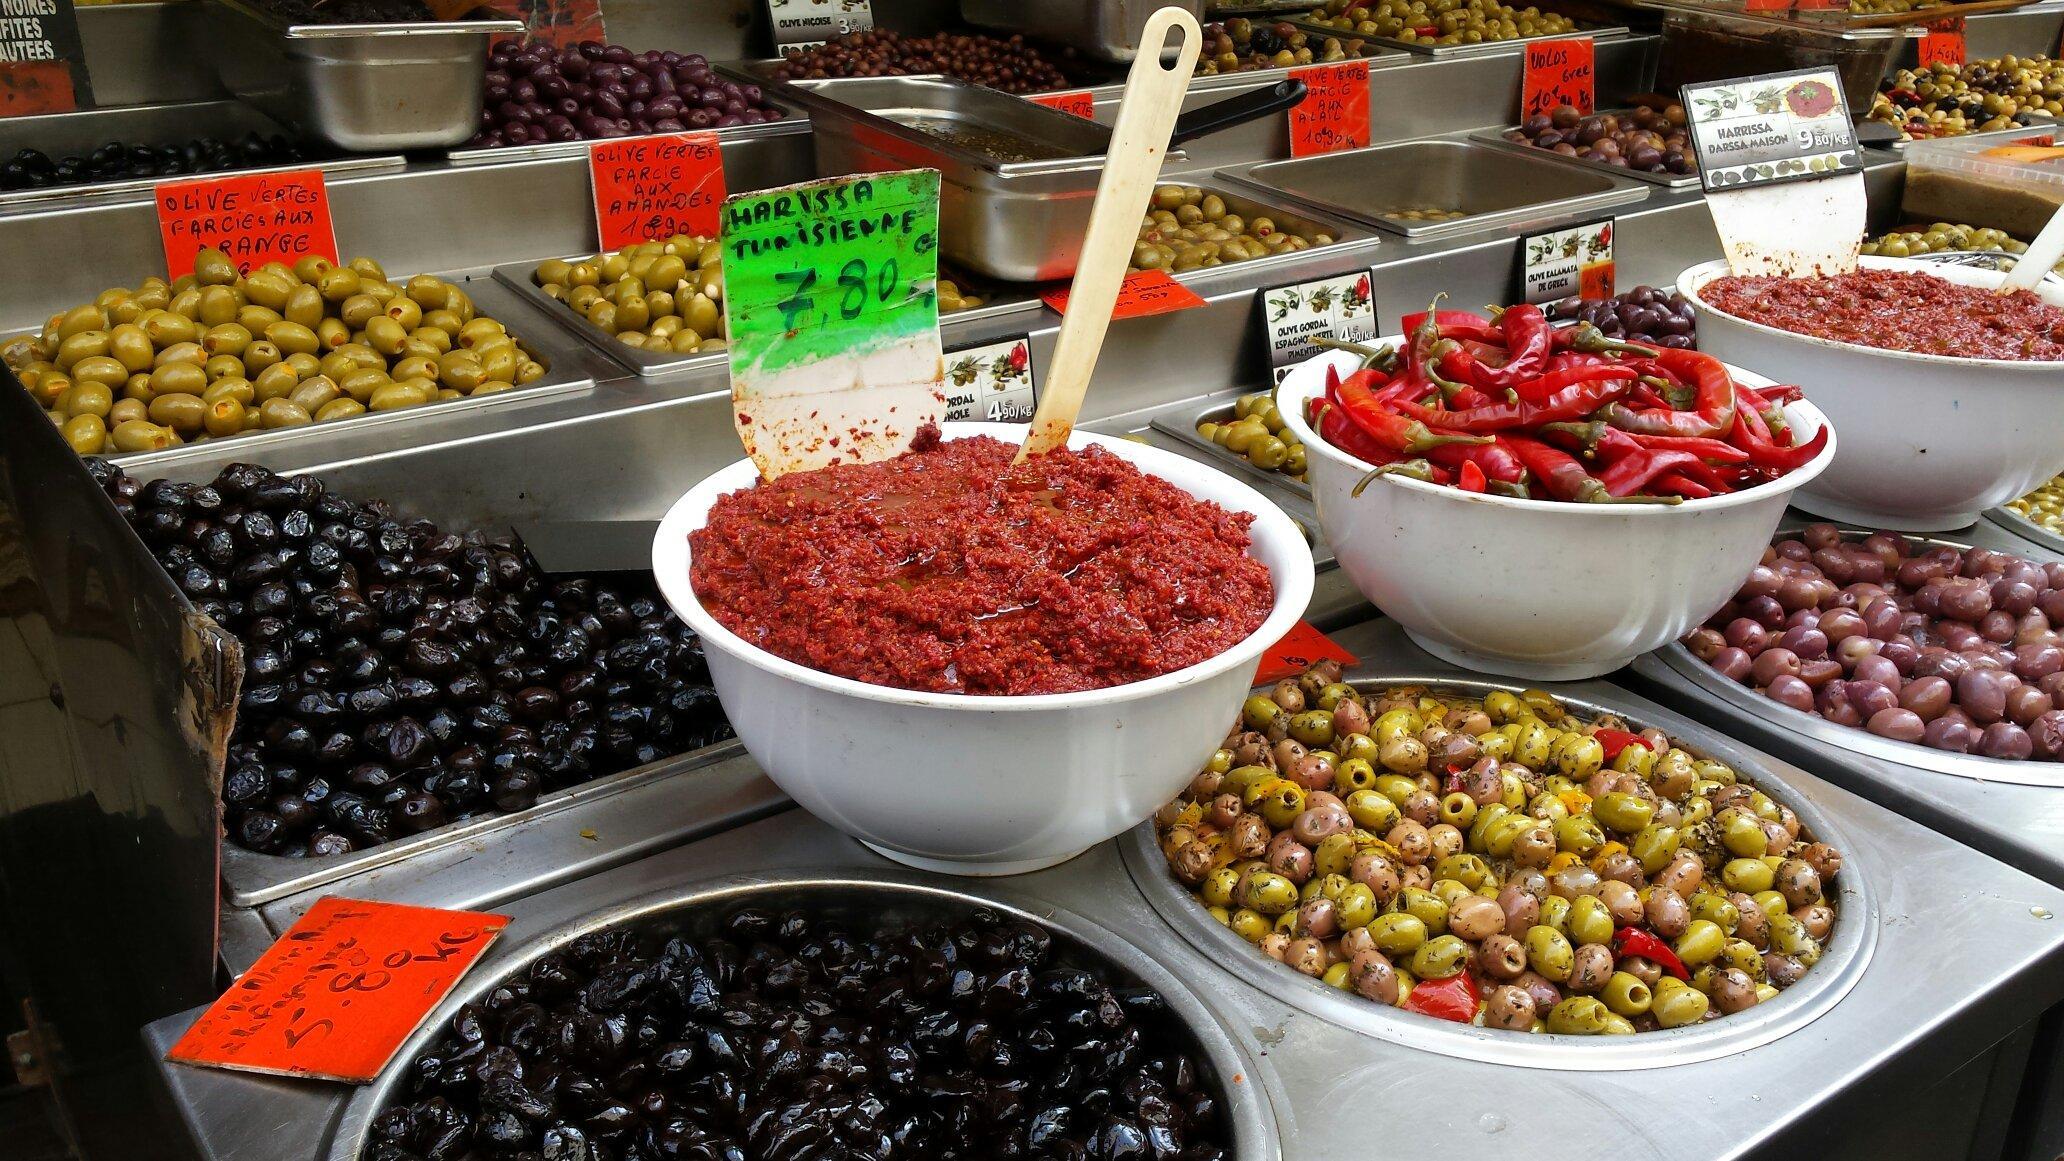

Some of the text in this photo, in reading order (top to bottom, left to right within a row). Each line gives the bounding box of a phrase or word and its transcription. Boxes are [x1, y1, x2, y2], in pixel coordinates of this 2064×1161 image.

[2, 0, 57, 16] NOIRES
[0, 17, 43, 39] FITES
[780, 18, 801, 29] OLIVE
[1308, 82, 1352, 100] ARCIE
[1717, 122, 1774, 140] HARRISSA
[1707, 134, 1789, 155] DARSSA MAISON
[729, 180, 874, 231] HARISSA
[1528, 270, 1545, 283] OLIVE
[1538, 282, 1547, 293] DE
[1277, 318, 1329, 338] OLIVE GORDAL
[1275, 334, 1311, 350] ESPAGNO
[944, 408, 970, 422] NOLE
